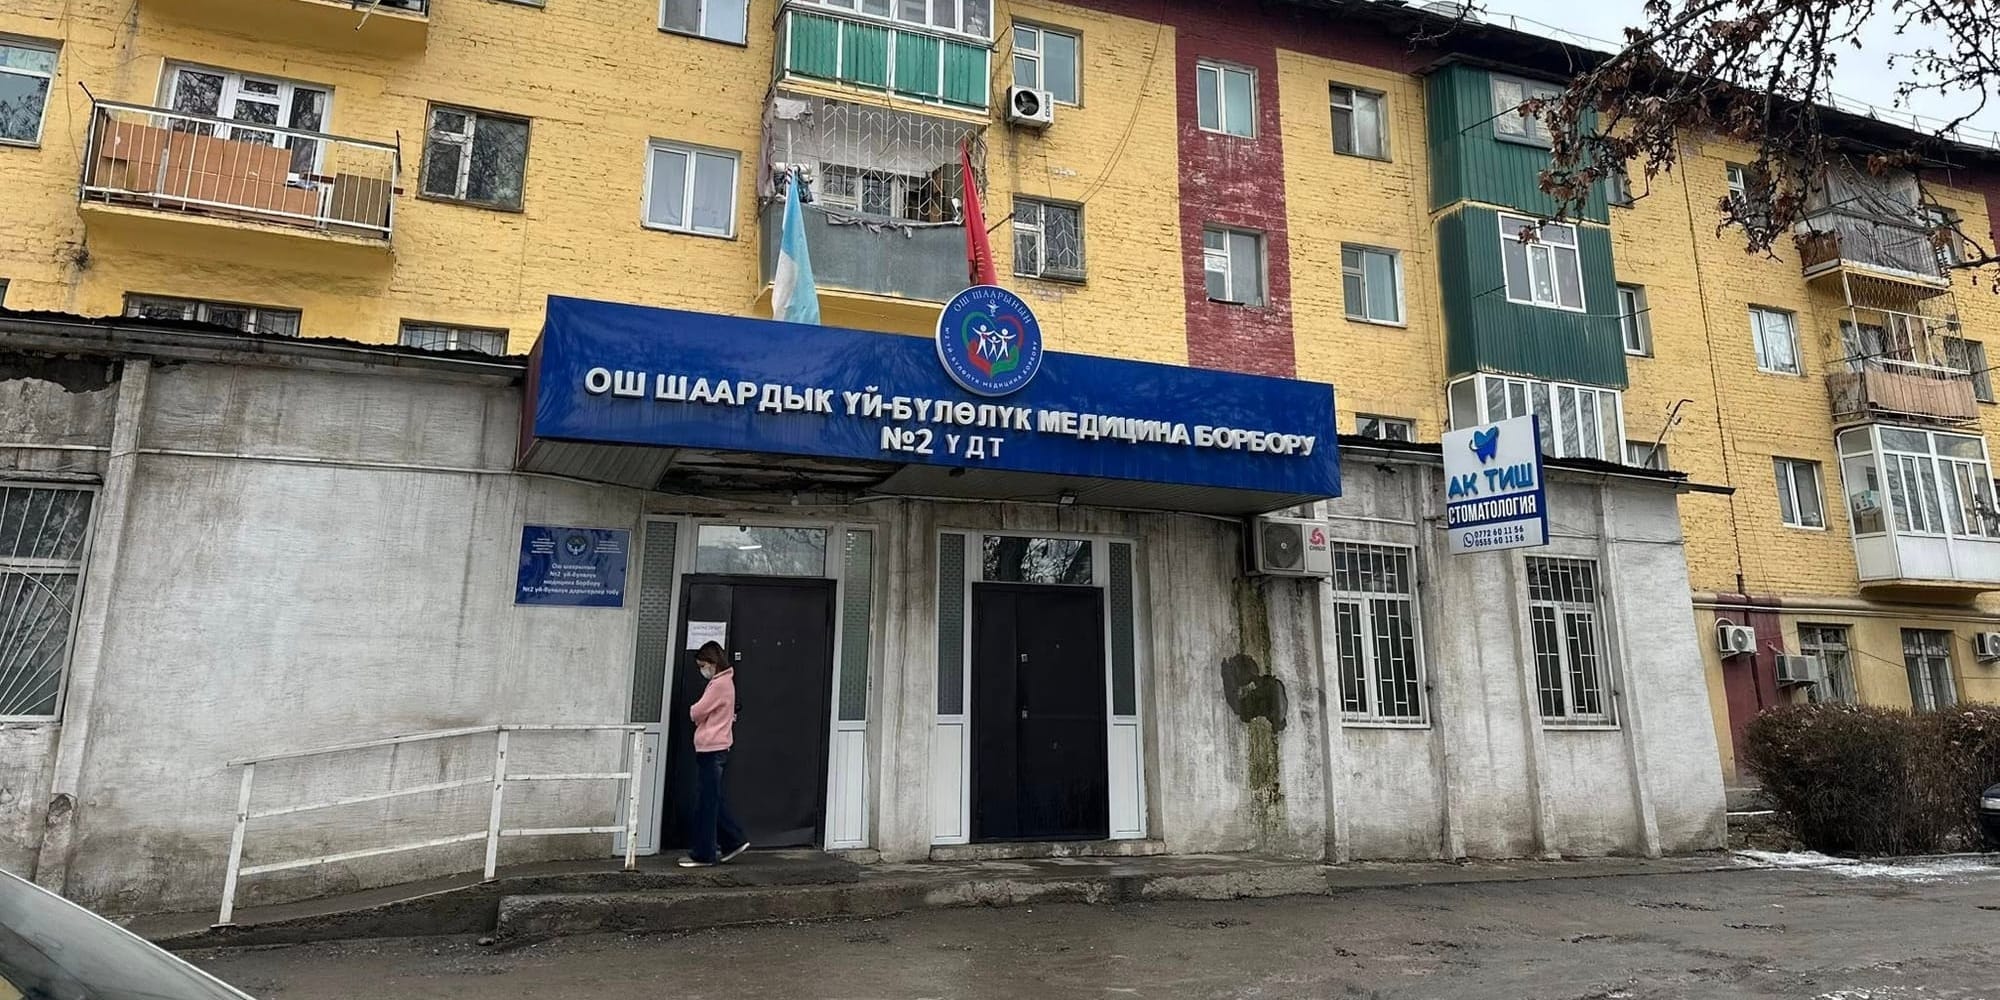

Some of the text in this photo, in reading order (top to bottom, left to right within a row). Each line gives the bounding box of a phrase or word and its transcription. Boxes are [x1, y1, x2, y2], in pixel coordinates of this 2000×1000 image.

[953, 289, 1032, 324] ОШ ШААРЫНЫН
[982, 375, 1023, 389] МЕДИЦИНА
[584, 367, 1316, 456] ОШ ШААРДЫК ҮЙ-БҮЛӨЛҮК МЕДИЦИНА БОРБОРУ
[881, 426, 934, 455] №2
[1448, 462, 1534, 498] АК ТИШ
[1448, 494, 1537, 524] СТОМАТОЛОГИЯ
[1474, 525, 1524, 538] 0772 60 11 56
[1475, 538, 1491, 546] 0555
